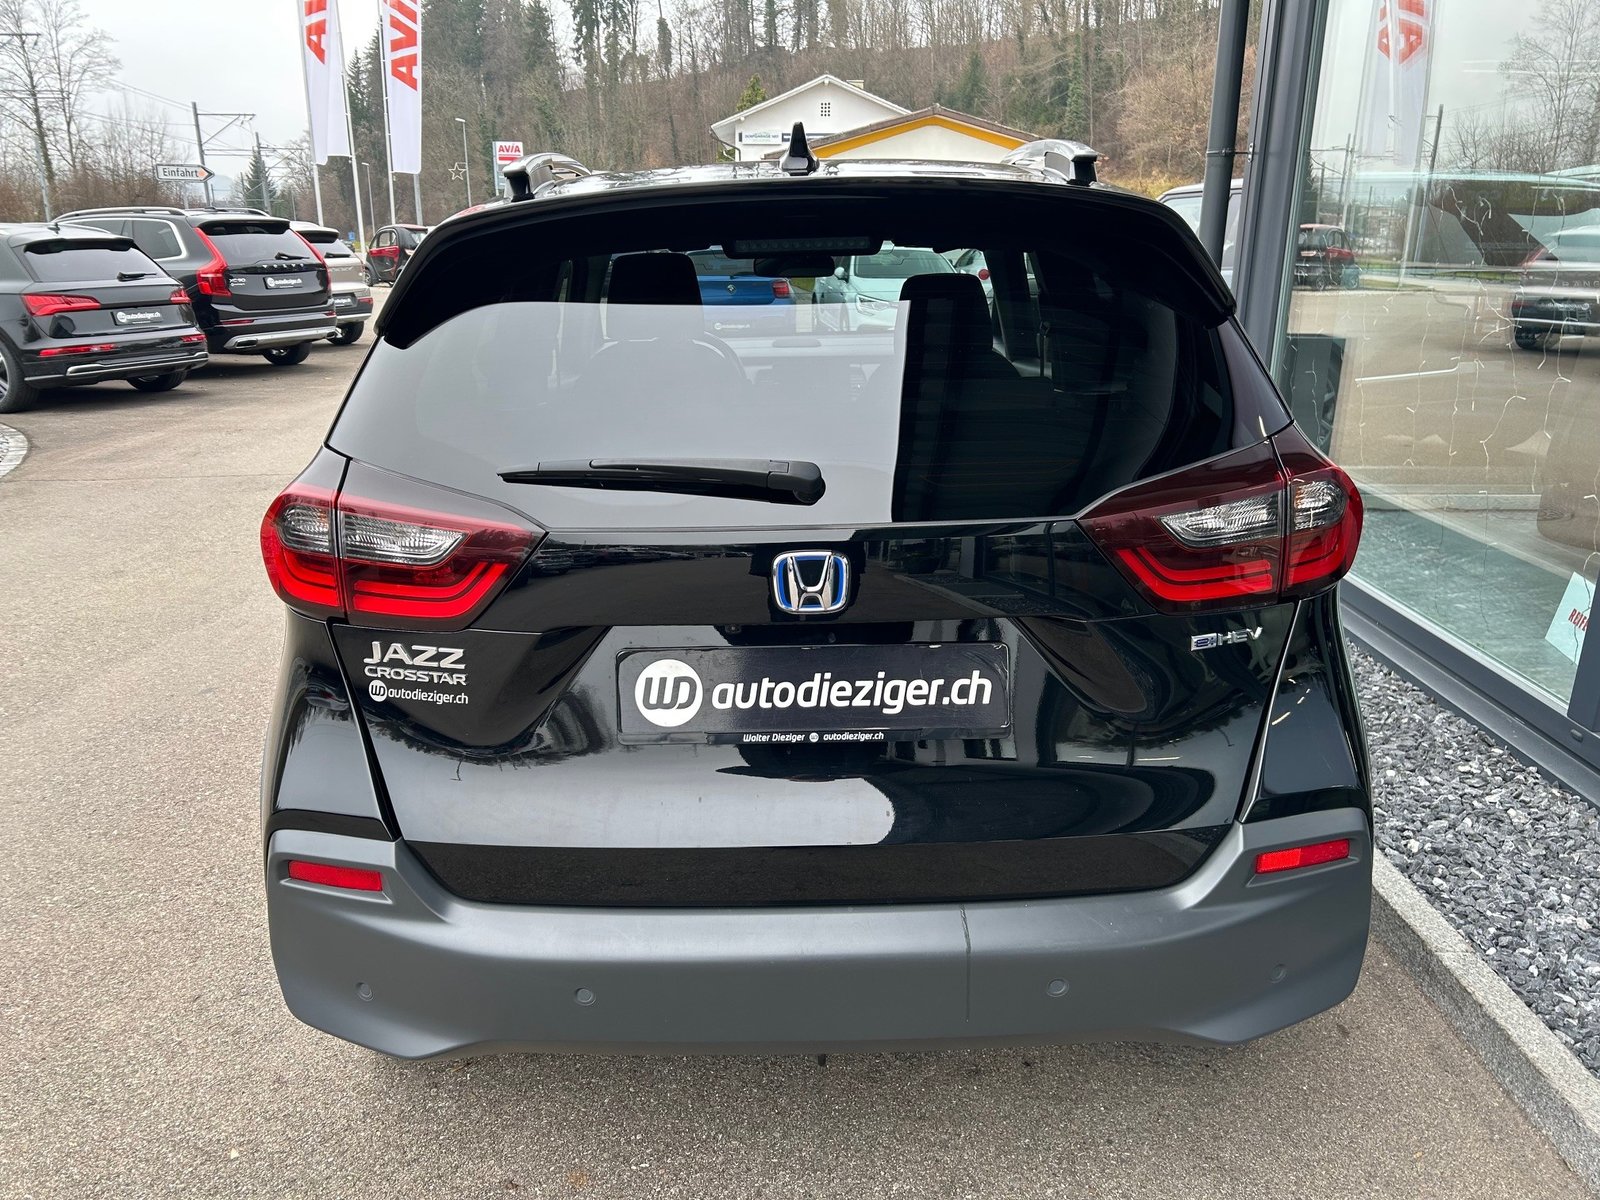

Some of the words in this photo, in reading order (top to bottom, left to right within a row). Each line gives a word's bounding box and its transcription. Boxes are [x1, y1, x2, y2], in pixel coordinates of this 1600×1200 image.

[389, 0, 418, 91] AVI
[498, 145, 520, 153] AVIA
[162, 168, 199, 178] Einfahrt
[363, 641, 466, 669] JAZZ
[364, 665, 468, 686] CROSSTAR
[388, 689, 469, 705] autodieziger.ch
[711, 670, 993, 715] autodieziger.ch
[743, 733, 769, 742] Walter
[772, 733, 805, 743] Dieziger
[823, 732, 885, 742] autodieziger.ch
